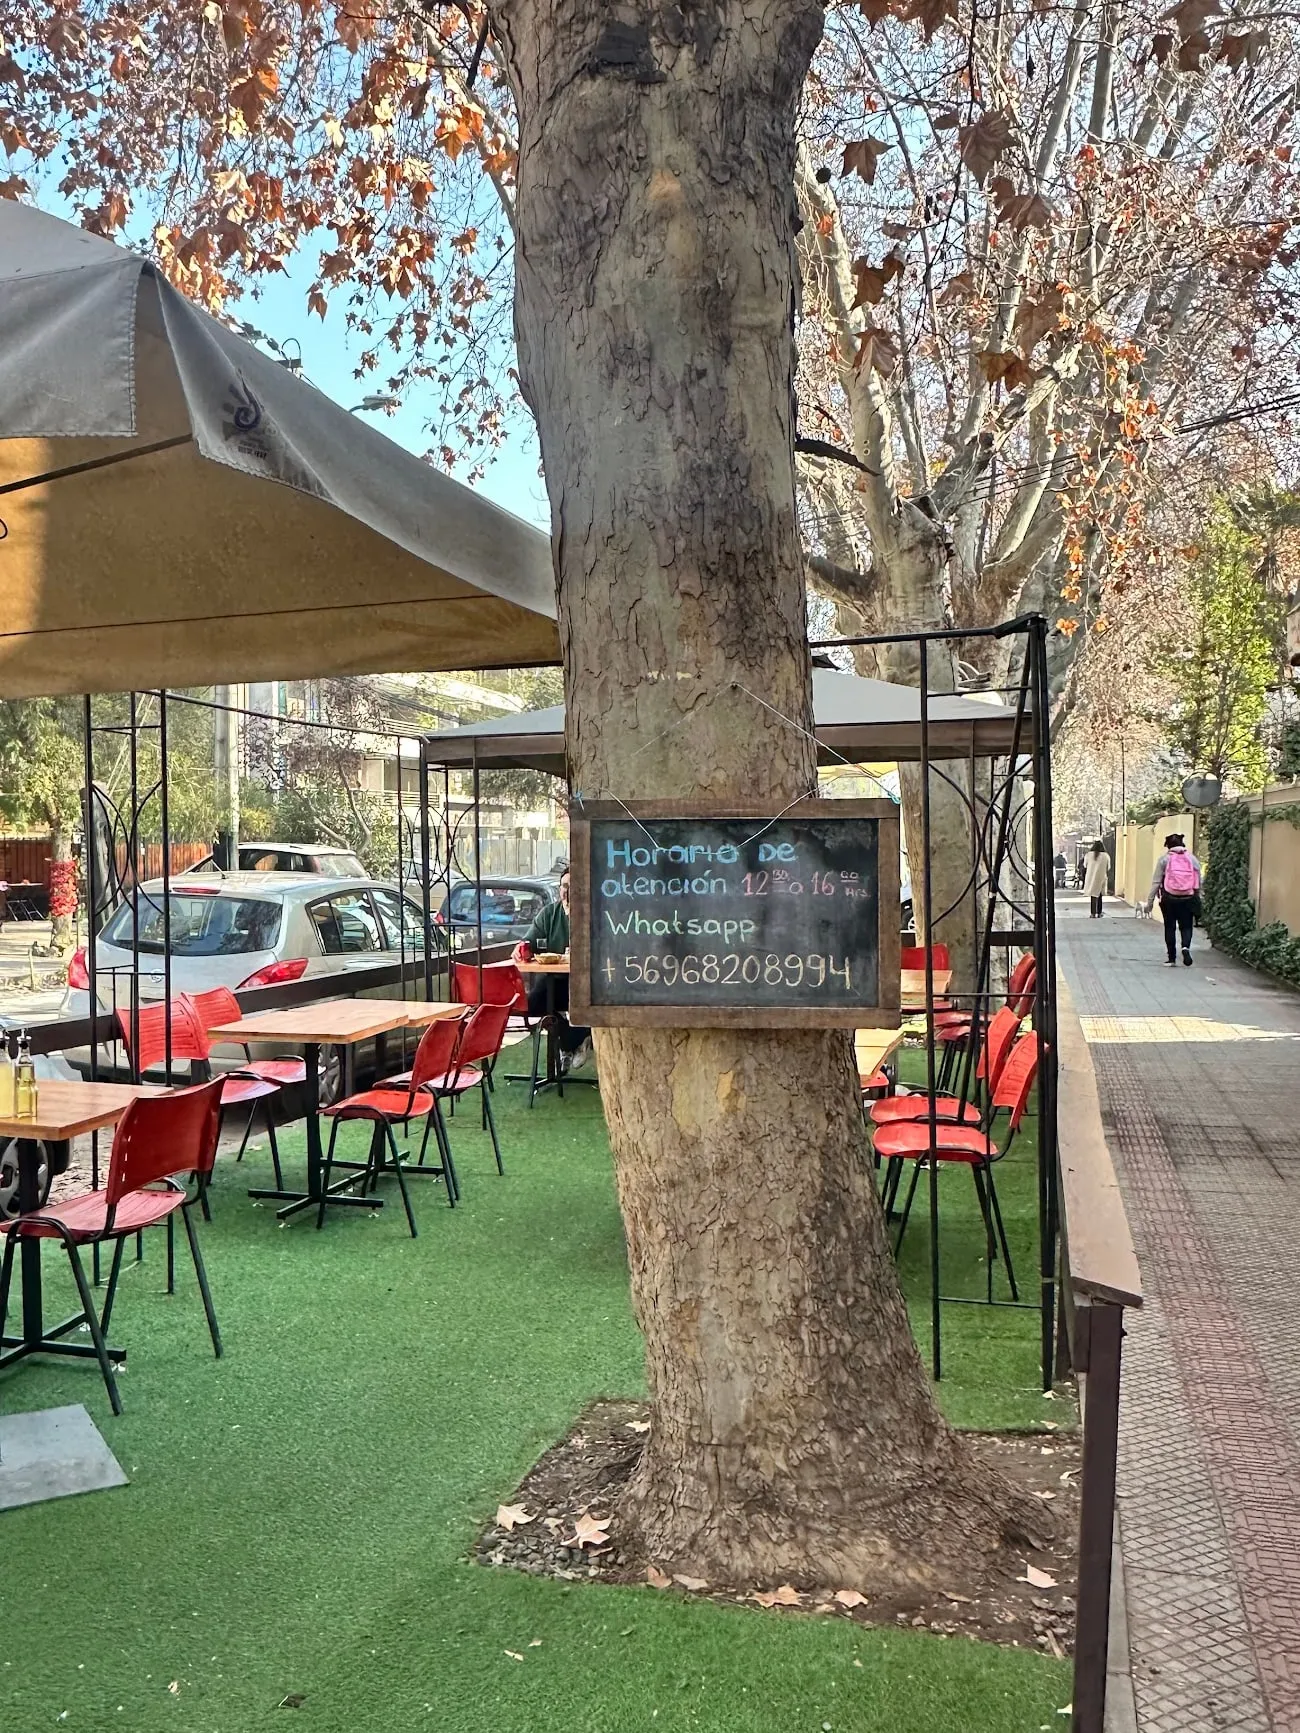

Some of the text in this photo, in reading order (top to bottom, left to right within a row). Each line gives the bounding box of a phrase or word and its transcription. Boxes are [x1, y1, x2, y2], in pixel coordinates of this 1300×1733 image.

[607, 839, 738, 868] Horario
[601, 869, 727, 898] atención
[605, 910, 754, 944] Whatsapp
